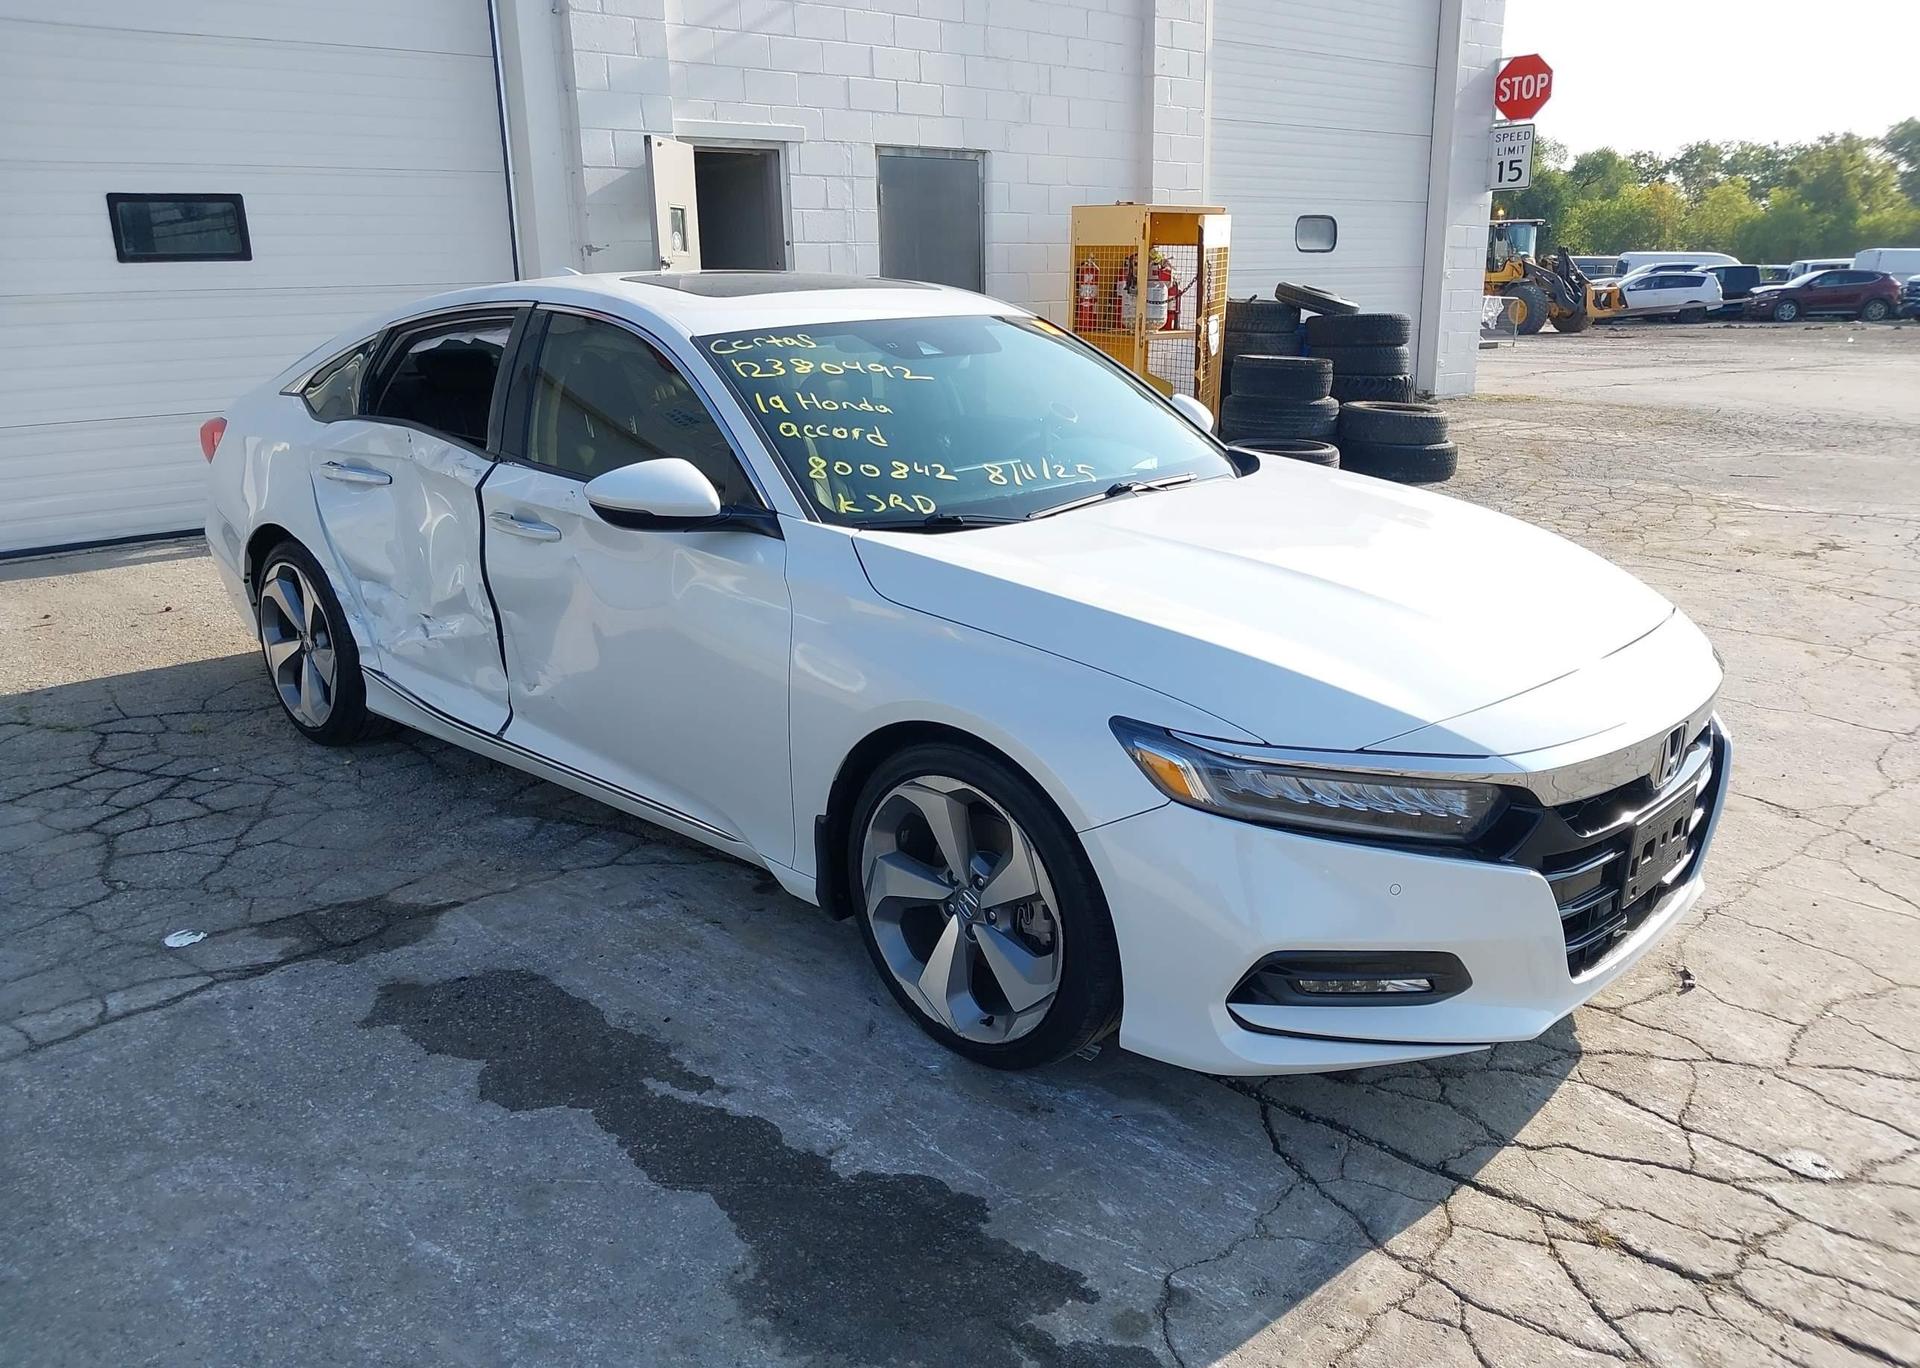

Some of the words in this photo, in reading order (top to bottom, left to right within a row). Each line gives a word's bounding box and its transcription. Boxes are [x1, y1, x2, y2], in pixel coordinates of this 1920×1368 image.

[1499, 73, 1549, 102] STOP
[1495, 130, 1531, 143] SPEED
[1497, 145, 1526, 156] LIMIT
[1497, 159, 1523, 183] 15
[731, 358, 935, 381] 12380492
[795, 391, 894, 415] Honda
